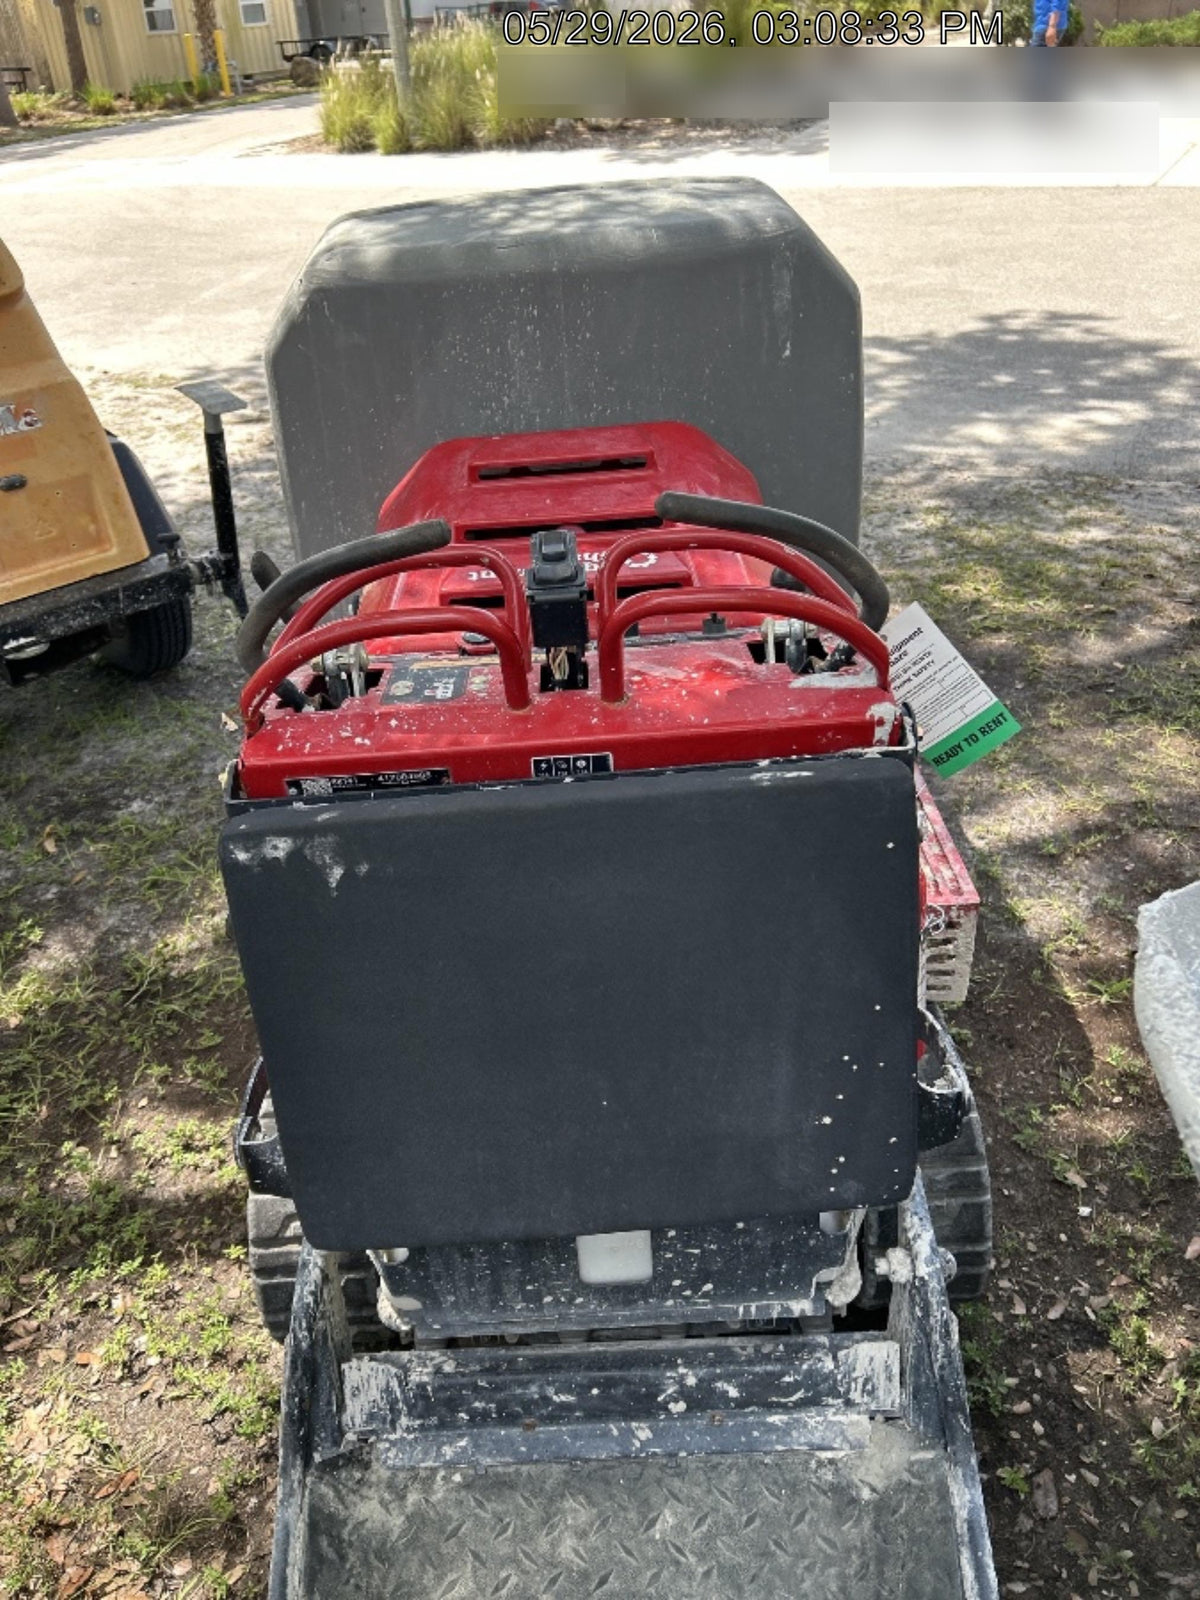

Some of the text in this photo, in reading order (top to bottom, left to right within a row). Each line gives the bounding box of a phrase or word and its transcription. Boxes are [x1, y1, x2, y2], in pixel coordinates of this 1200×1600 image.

[889, 627, 924, 656] uipment
[932, 712, 1008, 767] READY TO RENT
